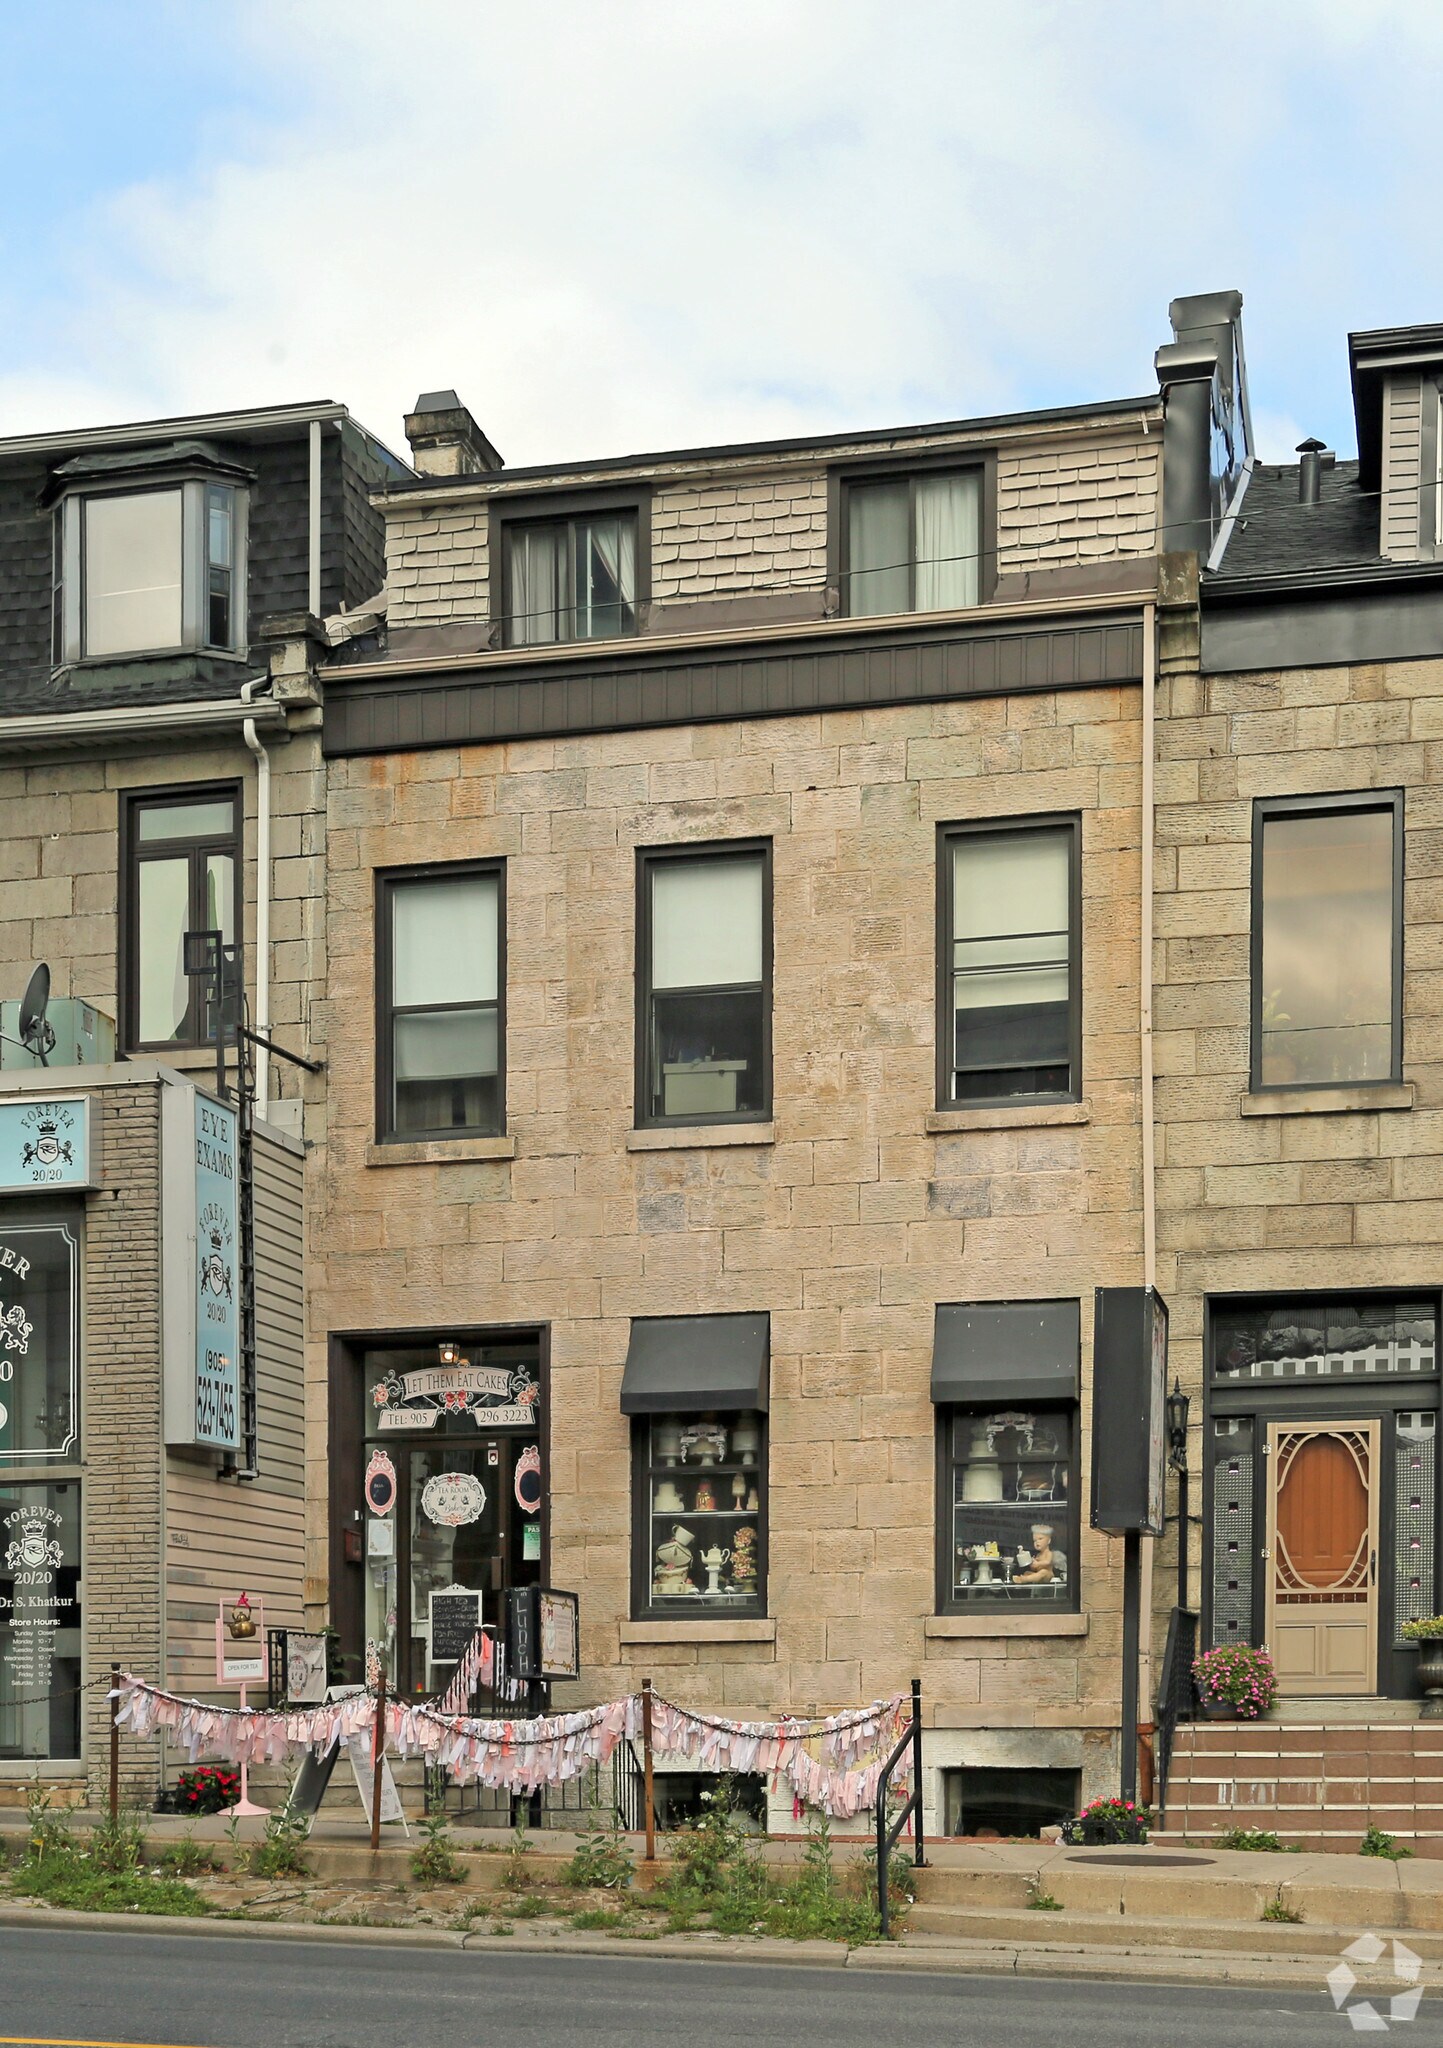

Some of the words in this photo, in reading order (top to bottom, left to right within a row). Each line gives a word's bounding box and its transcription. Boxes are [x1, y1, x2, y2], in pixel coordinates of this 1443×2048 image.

[21, 1103, 75, 1129] FOREVER
[201, 1107, 228, 1143] EYE
[196, 1139, 233, 1180] EXAMS
[32, 1168, 63, 1182] 20/20
[199, 1202, 232, 1246] FOREVER
[207, 1301, 227, 1324] 20/20
[205, 1348, 226, 1376] (905)
[406, 1376, 423, 1394] LET
[426, 1373, 454, 1390] THEM
[457, 1371, 474, 1387] EAT
[476, 1372, 507, 1391] CAKES
[197, 1375, 235, 1440] 523-7455
[480, 1411, 499, 1423] 296
[502, 1410, 528, 1422] 3223
[410, 1412, 428, 1425] 905
[438, 1486, 449, 1494] TEA
[450, 1486, 469, 1494] ROOM
[445, 1502, 467, 1513] Bakery
[3, 1505, 63, 1529] FOREVER
[14, 1571, 53, 1585] 20/20
[0, 1597, 14, 1608] Dr.
[16, 1596, 26, 1608] S.
[28, 1595, 74, 1607] Khatkur
[433, 1596, 452, 1605] HIGH
[9, 1618, 32, 1627] Store
[33, 1618, 61, 1626] Hours:
